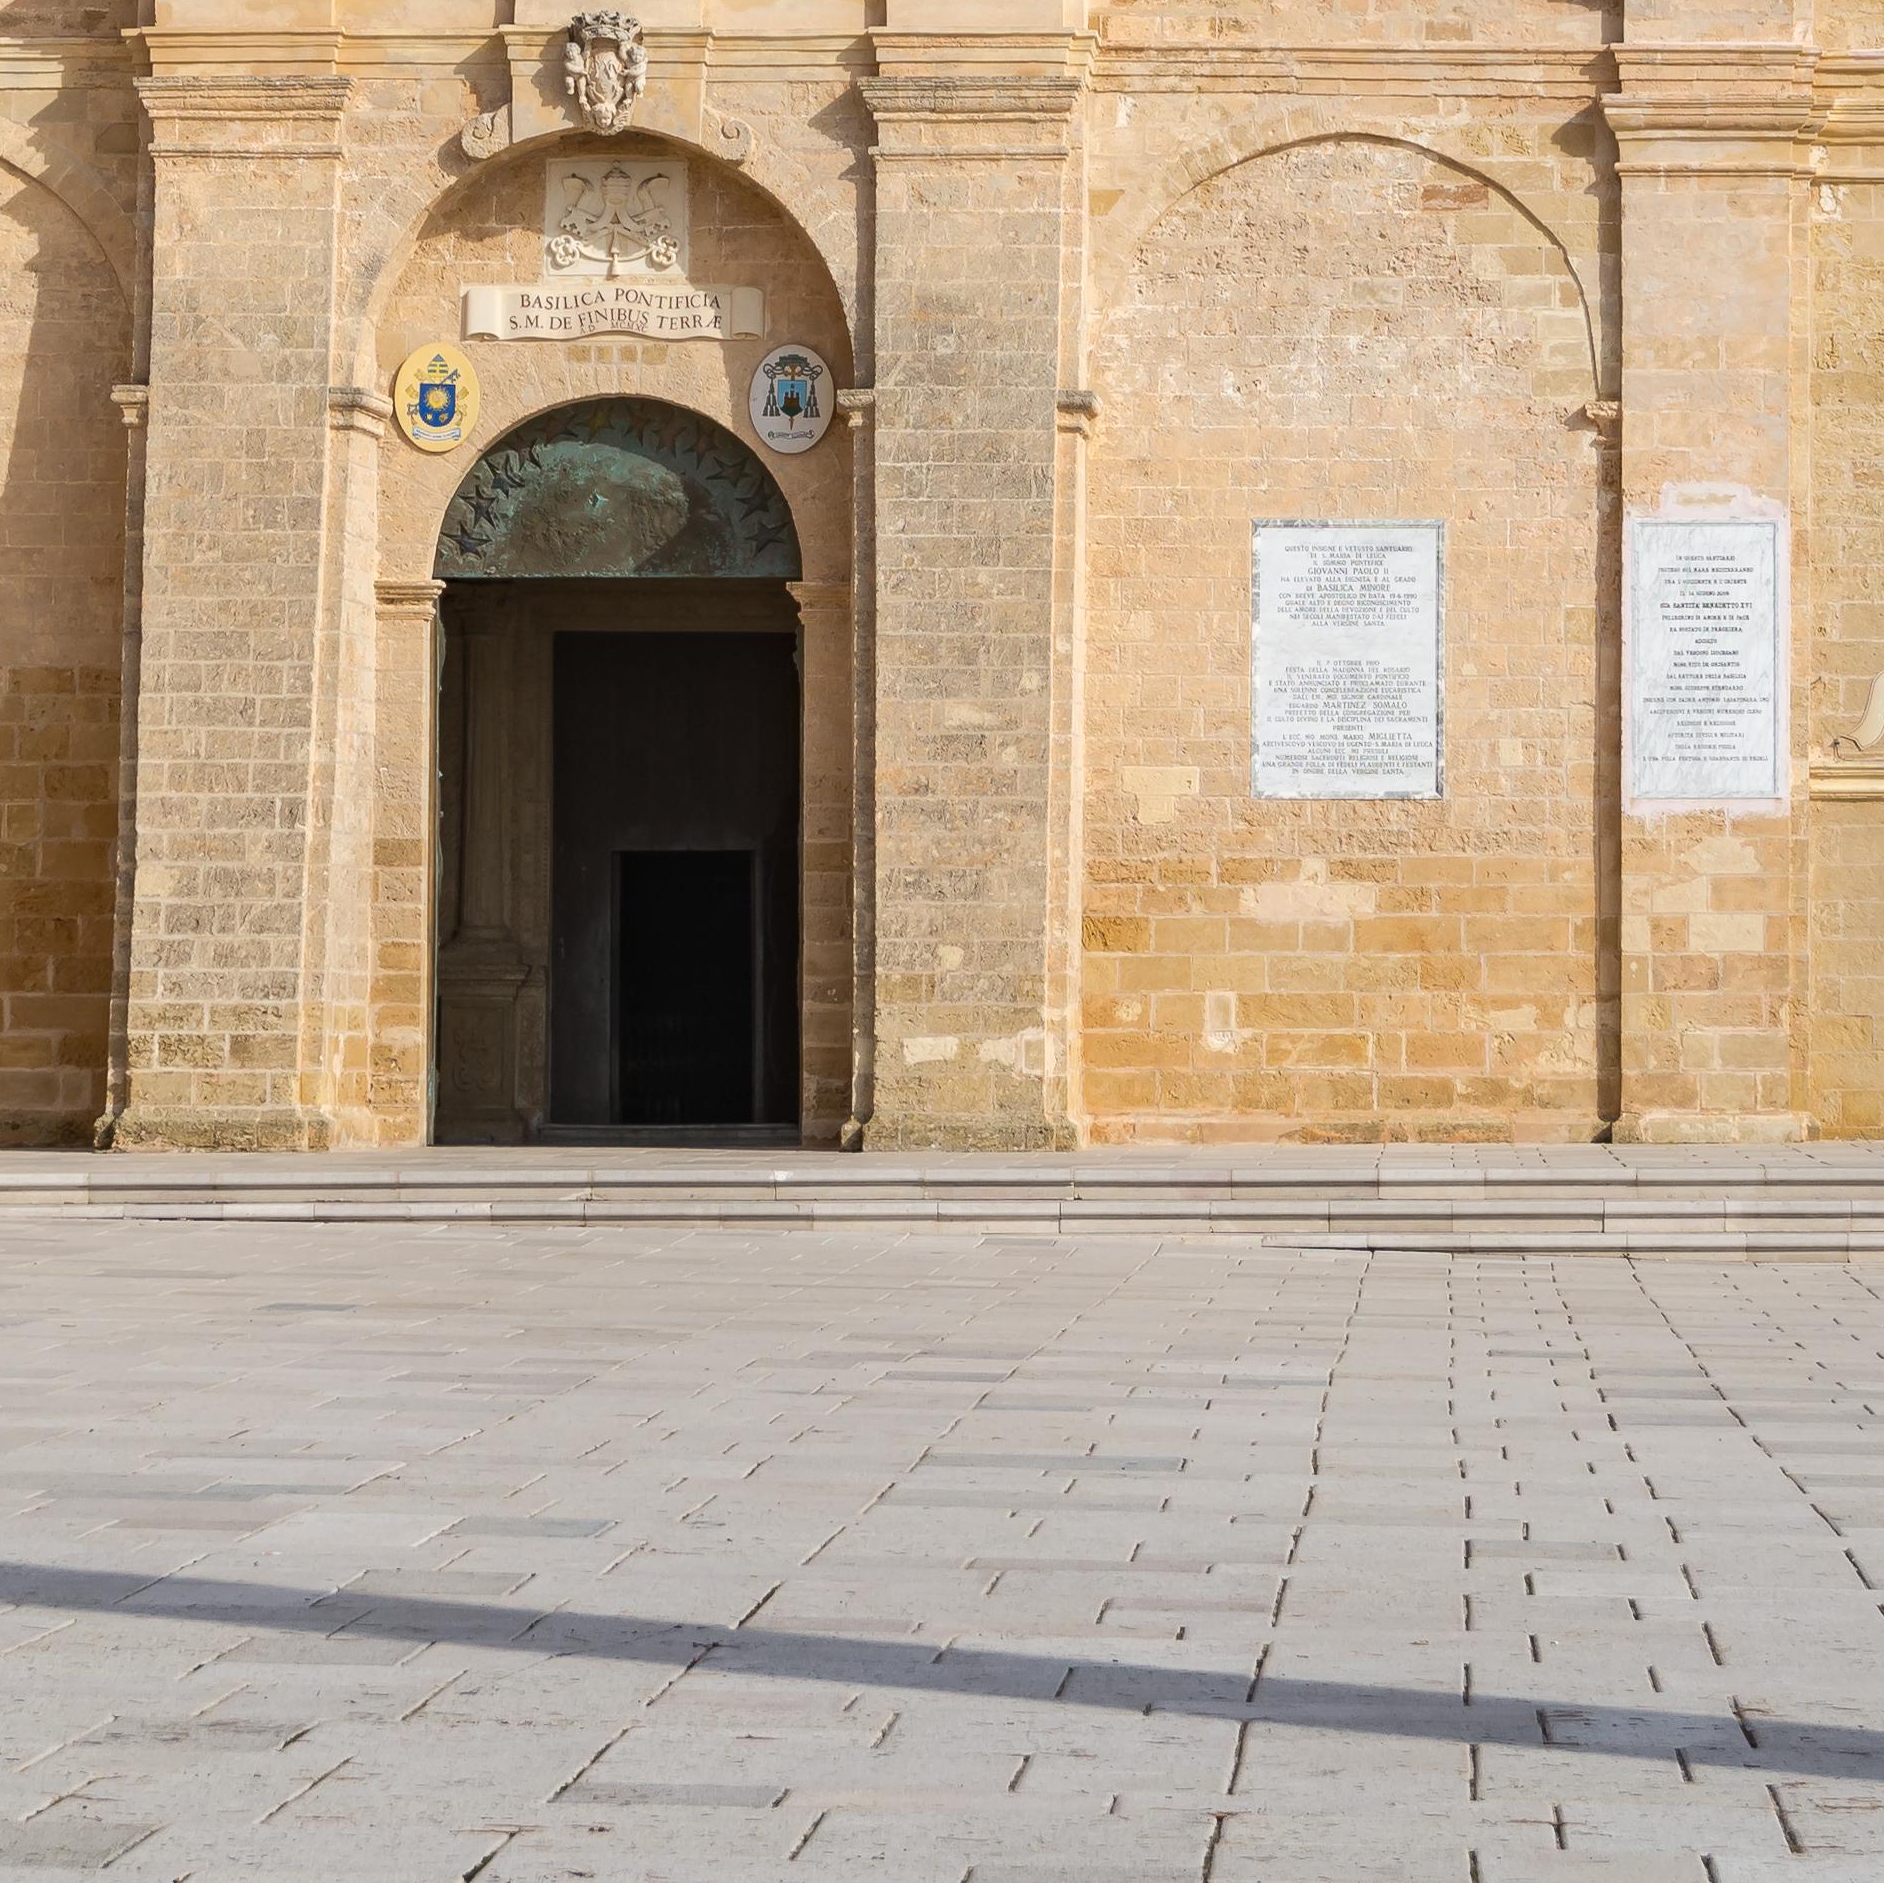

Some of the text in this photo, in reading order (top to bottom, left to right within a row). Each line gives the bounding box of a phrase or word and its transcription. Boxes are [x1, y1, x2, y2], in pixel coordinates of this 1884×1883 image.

[521, 288, 721, 309] BASILICA PONTIFICIA
[509, 315, 543, 330] S.M.
[550, 316, 572, 330] DE
[578, 308, 650, 327] FINIBUS
